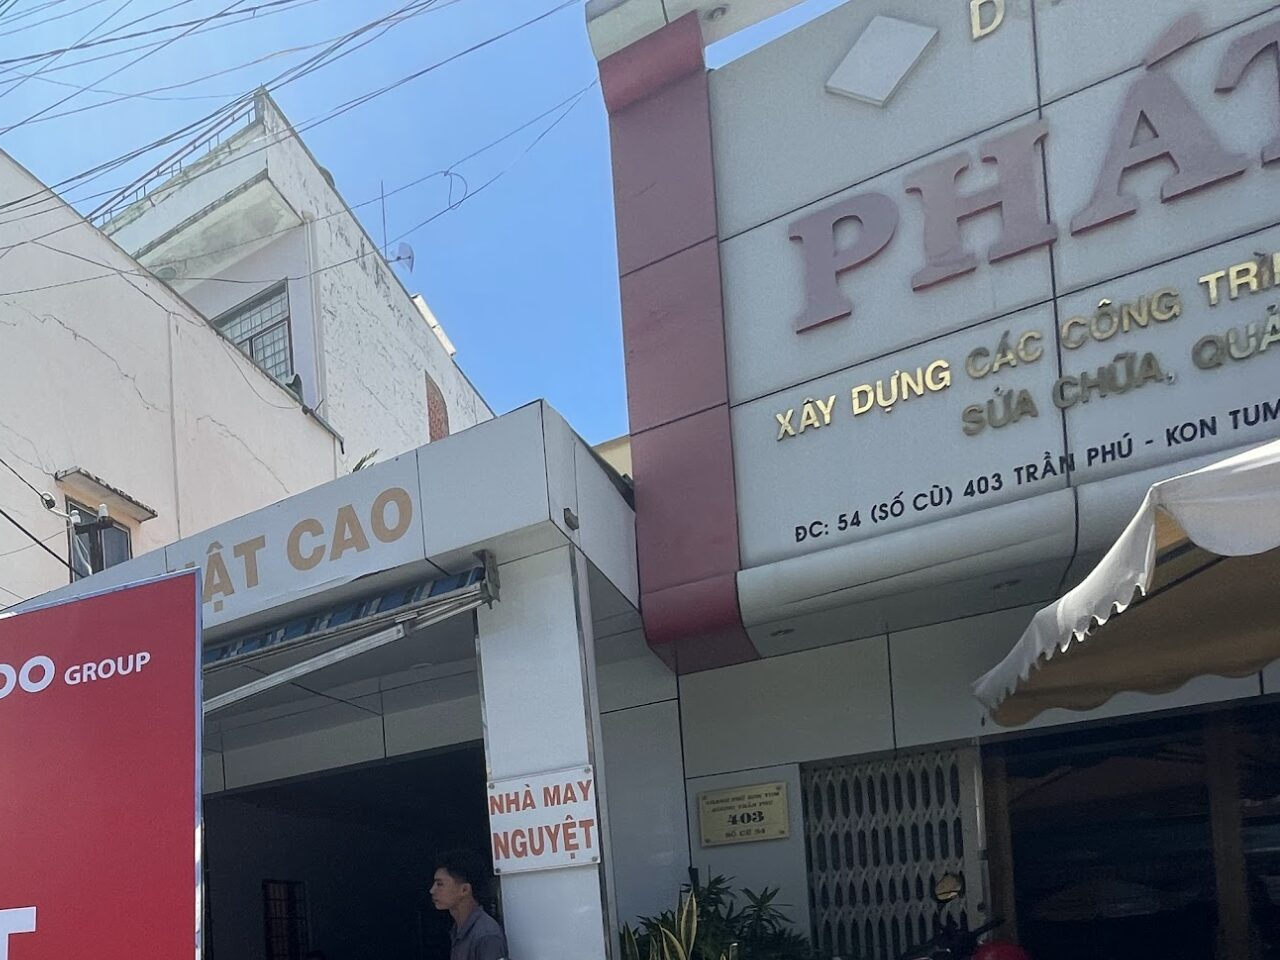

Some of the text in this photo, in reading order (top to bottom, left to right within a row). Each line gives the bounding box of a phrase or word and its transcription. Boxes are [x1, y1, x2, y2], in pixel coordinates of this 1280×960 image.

[775, 250, 1280, 441] XÂY DỰNG CÁC CÔNG TRÌ
[961, 384, 1040, 437] SỬA
[795, 520, 829, 542] ĐC:
[837, 510, 861, 530] 54
[870, 491, 905, 523] (SỐ
[913, 485, 953, 512] CŨ)
[963, 473, 1003, 497] 403
[1014, 450, 1076, 485] TRẦN
[1087, 433, 1133, 467] PHÚ
[1166, 416, 1218, 447] KON
[1228, 398, 1280, 431] TUM
[185, 487, 413, 613] ẬT CAO
[64, 651, 151, 686] GROUP
[489, 779, 592, 816] NHÀ MAY
[727, 810, 765, 826] 403
[493, 814, 595, 861] NGUYỆT
